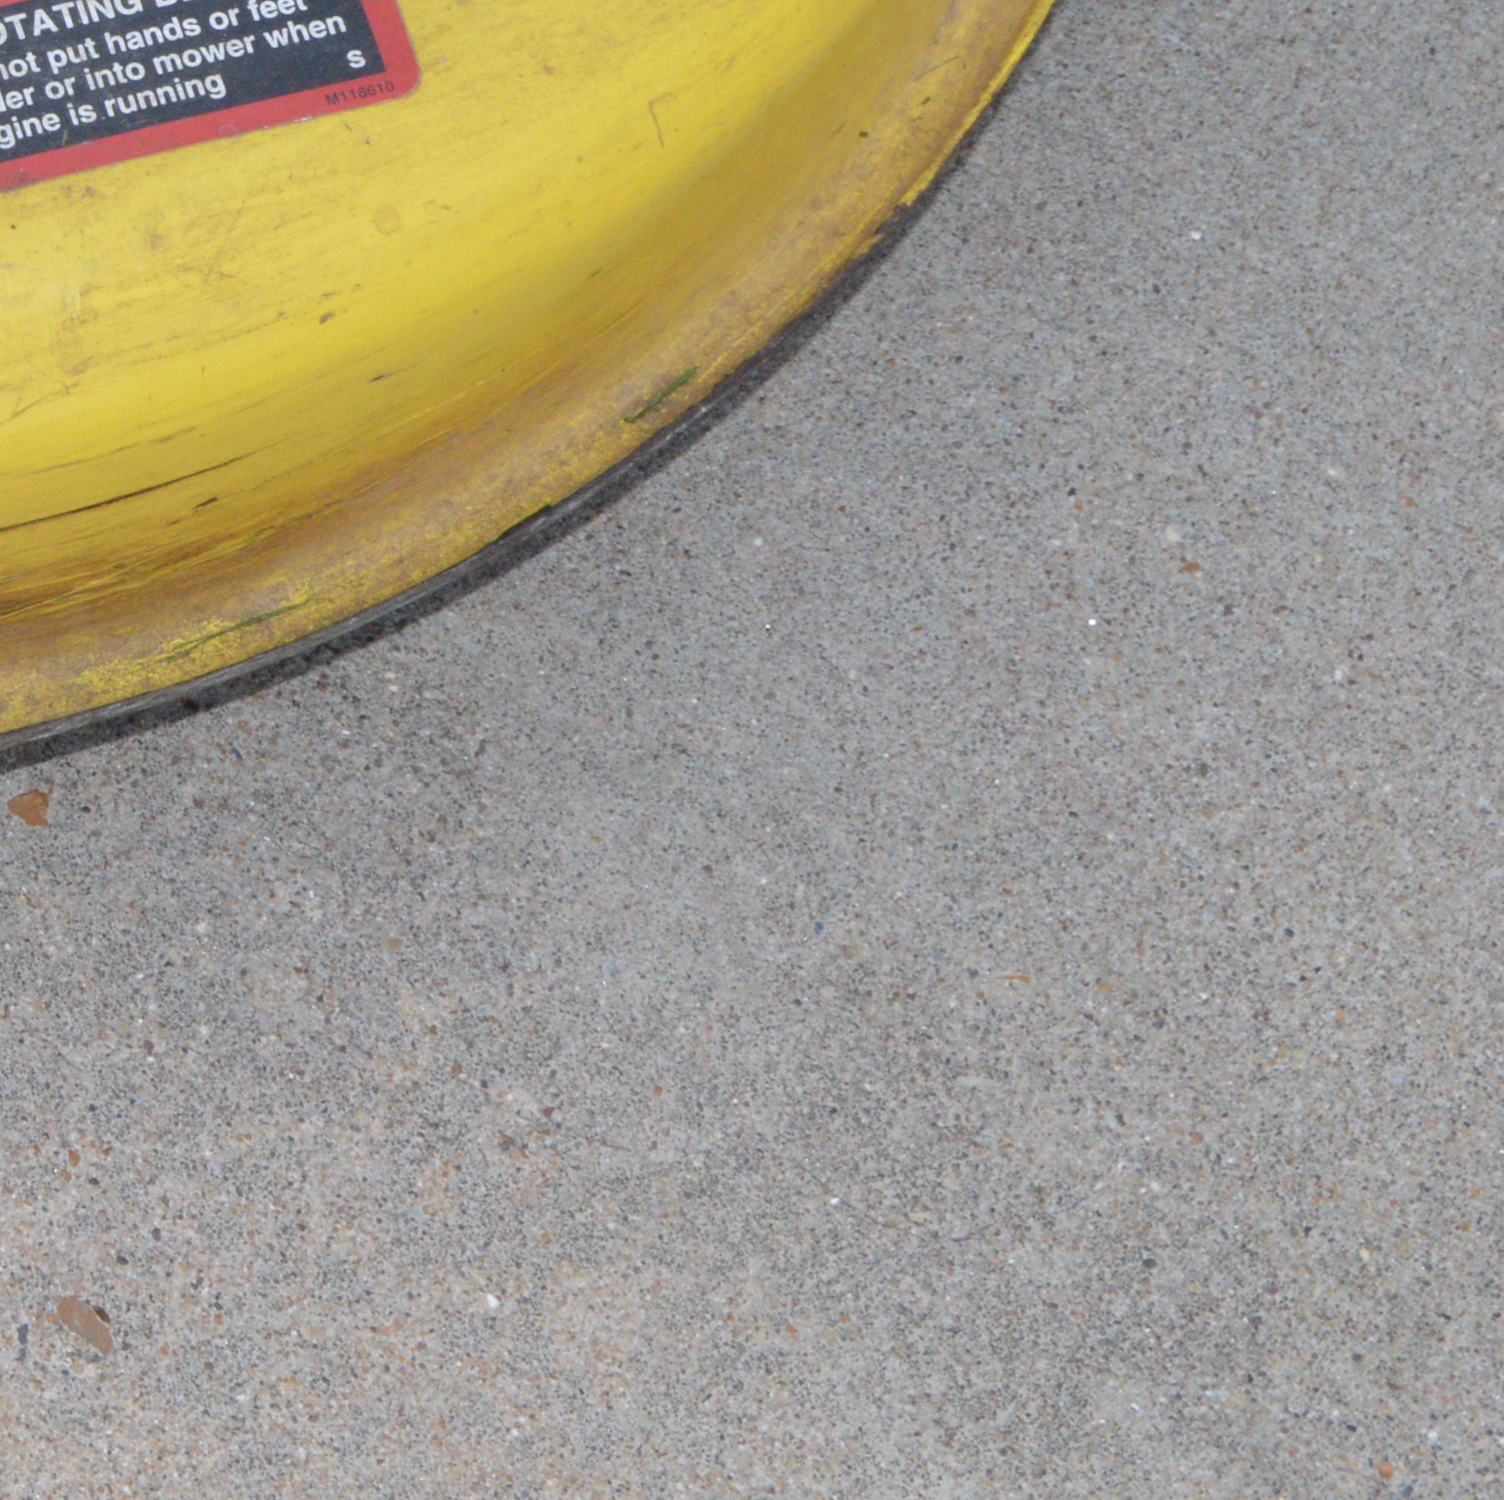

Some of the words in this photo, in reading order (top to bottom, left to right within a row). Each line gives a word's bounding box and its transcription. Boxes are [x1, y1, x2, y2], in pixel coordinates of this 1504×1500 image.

[44, 76, 76, 100] or
[84, 61, 146, 91] into
[152, 34, 256, 76] mower
[262, 14, 347, 49] when
[46, 37, 99, 75] put
[104, 16, 202, 55] hands
[208, 7, 239, 31] or
[66, 102, 98, 127] is
[103, 73, 227, 118] running
